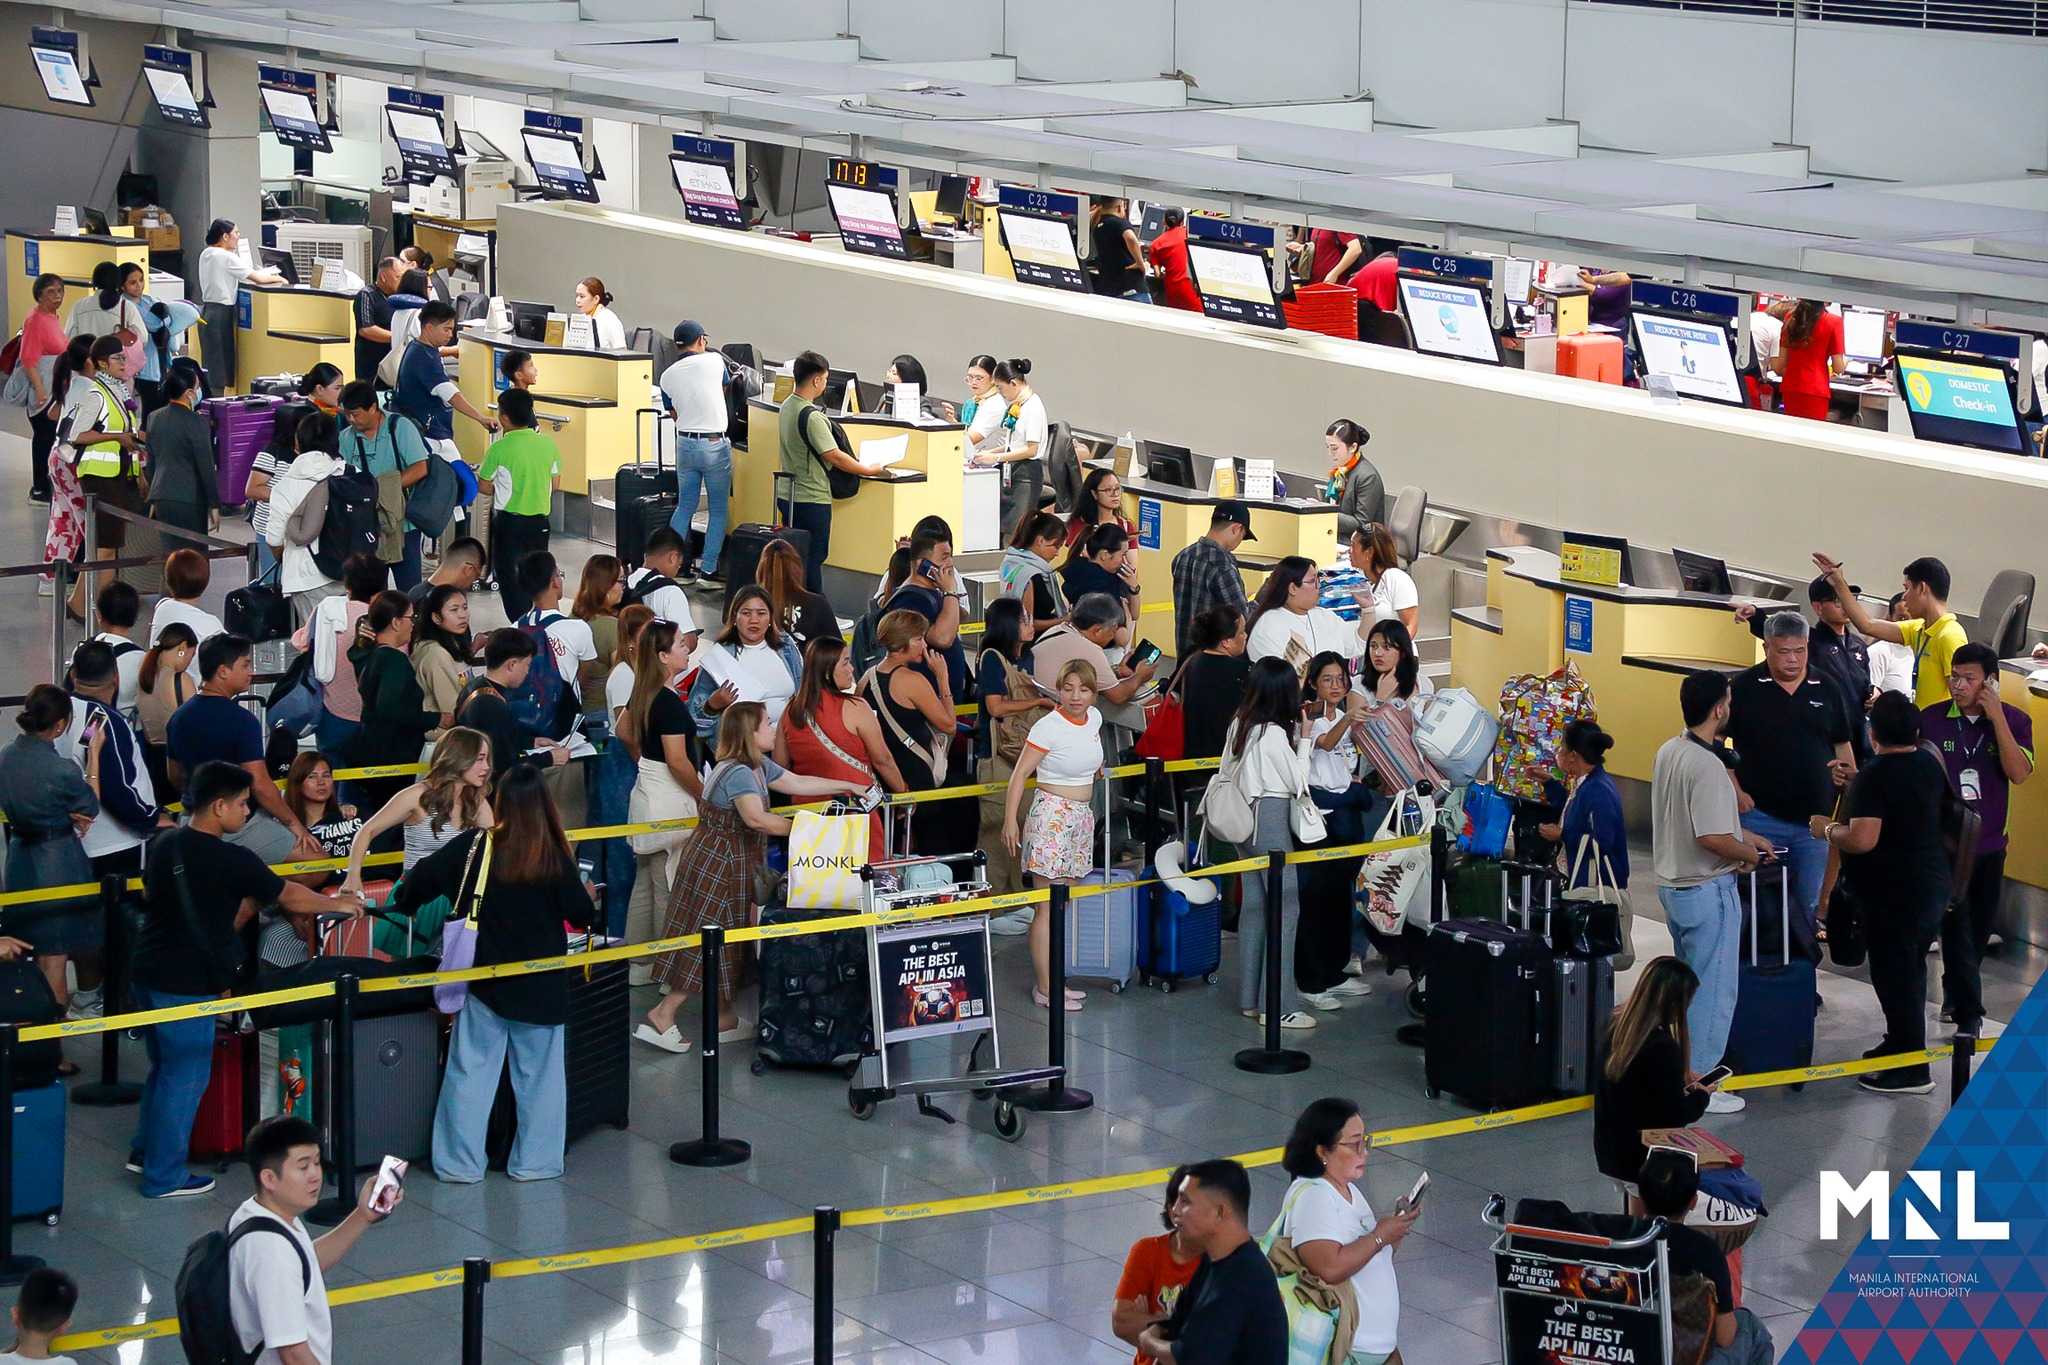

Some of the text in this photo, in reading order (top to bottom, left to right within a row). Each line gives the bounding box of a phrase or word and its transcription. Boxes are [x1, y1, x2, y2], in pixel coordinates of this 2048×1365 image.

[547, 116, 552, 126] C
[697, 141, 712, 153] C 21
[1028, 193, 1048, 207] C 23
[1221, 223, 1242, 239] C 24
[1432, 256, 1457, 272] C 25
[1671, 290, 1697, 308] C 26
[1654, 325, 1680, 337] REDUCE
[1943, 331, 1970, 348] C 27
[1948, 378, 1991, 394] DOMESTIC
[1952, 395, 1997, 414] Check-in
[320, 818, 363, 839] THANKS
[903, 952, 958, 971] THE BEST
[898, 965, 966, 986] API IN ASIA
[1510, 1264, 1554, 1279] THE BEST
[1507, 1273, 1561, 1289] API IN ASIA
[1544, 1319, 1624, 1345] THE BEST
[1538, 1335, 1568, 1353] API
[1572, 1340, 1590, 1356] IN
[1594, 1344, 1635, 1363] ASIA
